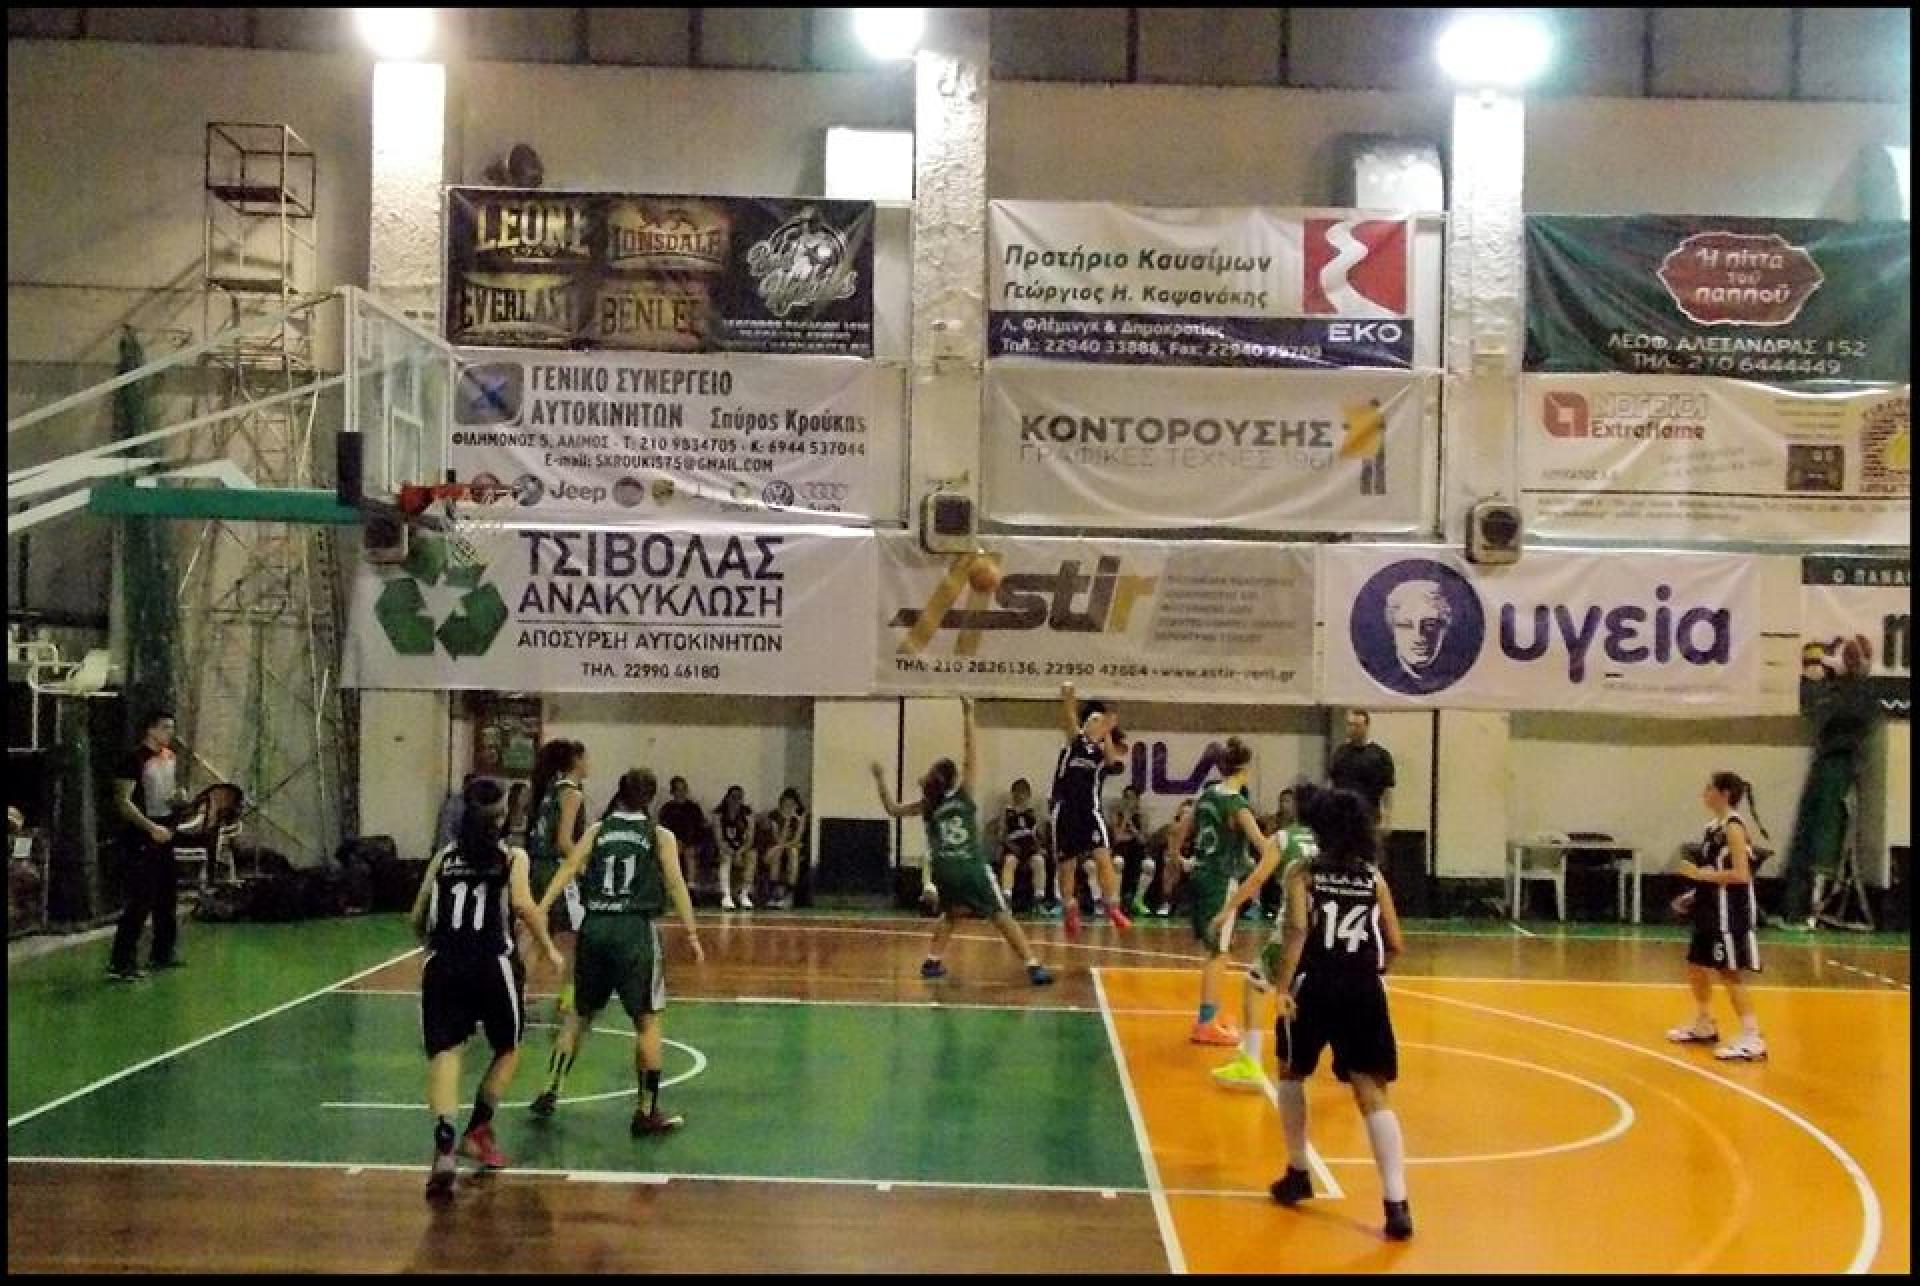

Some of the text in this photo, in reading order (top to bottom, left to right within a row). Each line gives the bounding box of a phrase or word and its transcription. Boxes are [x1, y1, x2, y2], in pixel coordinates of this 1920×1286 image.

[1138, 246, 1272, 276] Καυσίμων
[1004, 280, 1103, 304] Γεώργιος
[1112, 284, 1133, 300] Η.
[1104, 319, 1117, 333] &
[1328, 323, 1402, 343] EKO
[1828, 338, 1868, 357] 152
[1688, 355, 1734, 371] 210
[1739, 357, 1841, 375] 6444449
[531, 365, 733, 396] ΓΕΝΙΚΟ ΣΥΝΕΡΓΕΙΟ
[531, 400, 867, 436] ΑΥΤΟΚΙΝΗΤΩΝ Σπύρος Κρούκης
[1020, 415, 1333, 447] ΚΟΝΤΟΡΟΥΣΗΣ
[557, 435, 609, 449] ΑΛΙΜΟΣ
[639, 437, 667, 450] 210
[550, 480, 607, 504] Jeep
[519, 530, 784, 580] ΤΣΙΒΟΛΑΣ
[518, 582, 783, 618] ΑΝΑΚΥΚΛΩΣΗ
[518, 629, 783, 653] ΑΠΟΣΥΡΣΗ ΑΥΤΟΚΙΝΗΤΩΝ
[1500, 584, 1732, 684] υγεία
[623, 663, 669, 679] 22990
[673, 664, 720, 680] 46180
[934, 659, 963, 673] 210
[602, 854, 637, 897] 11
[451, 881, 487, 931] 11
[1322, 900, 1369, 953] 14
